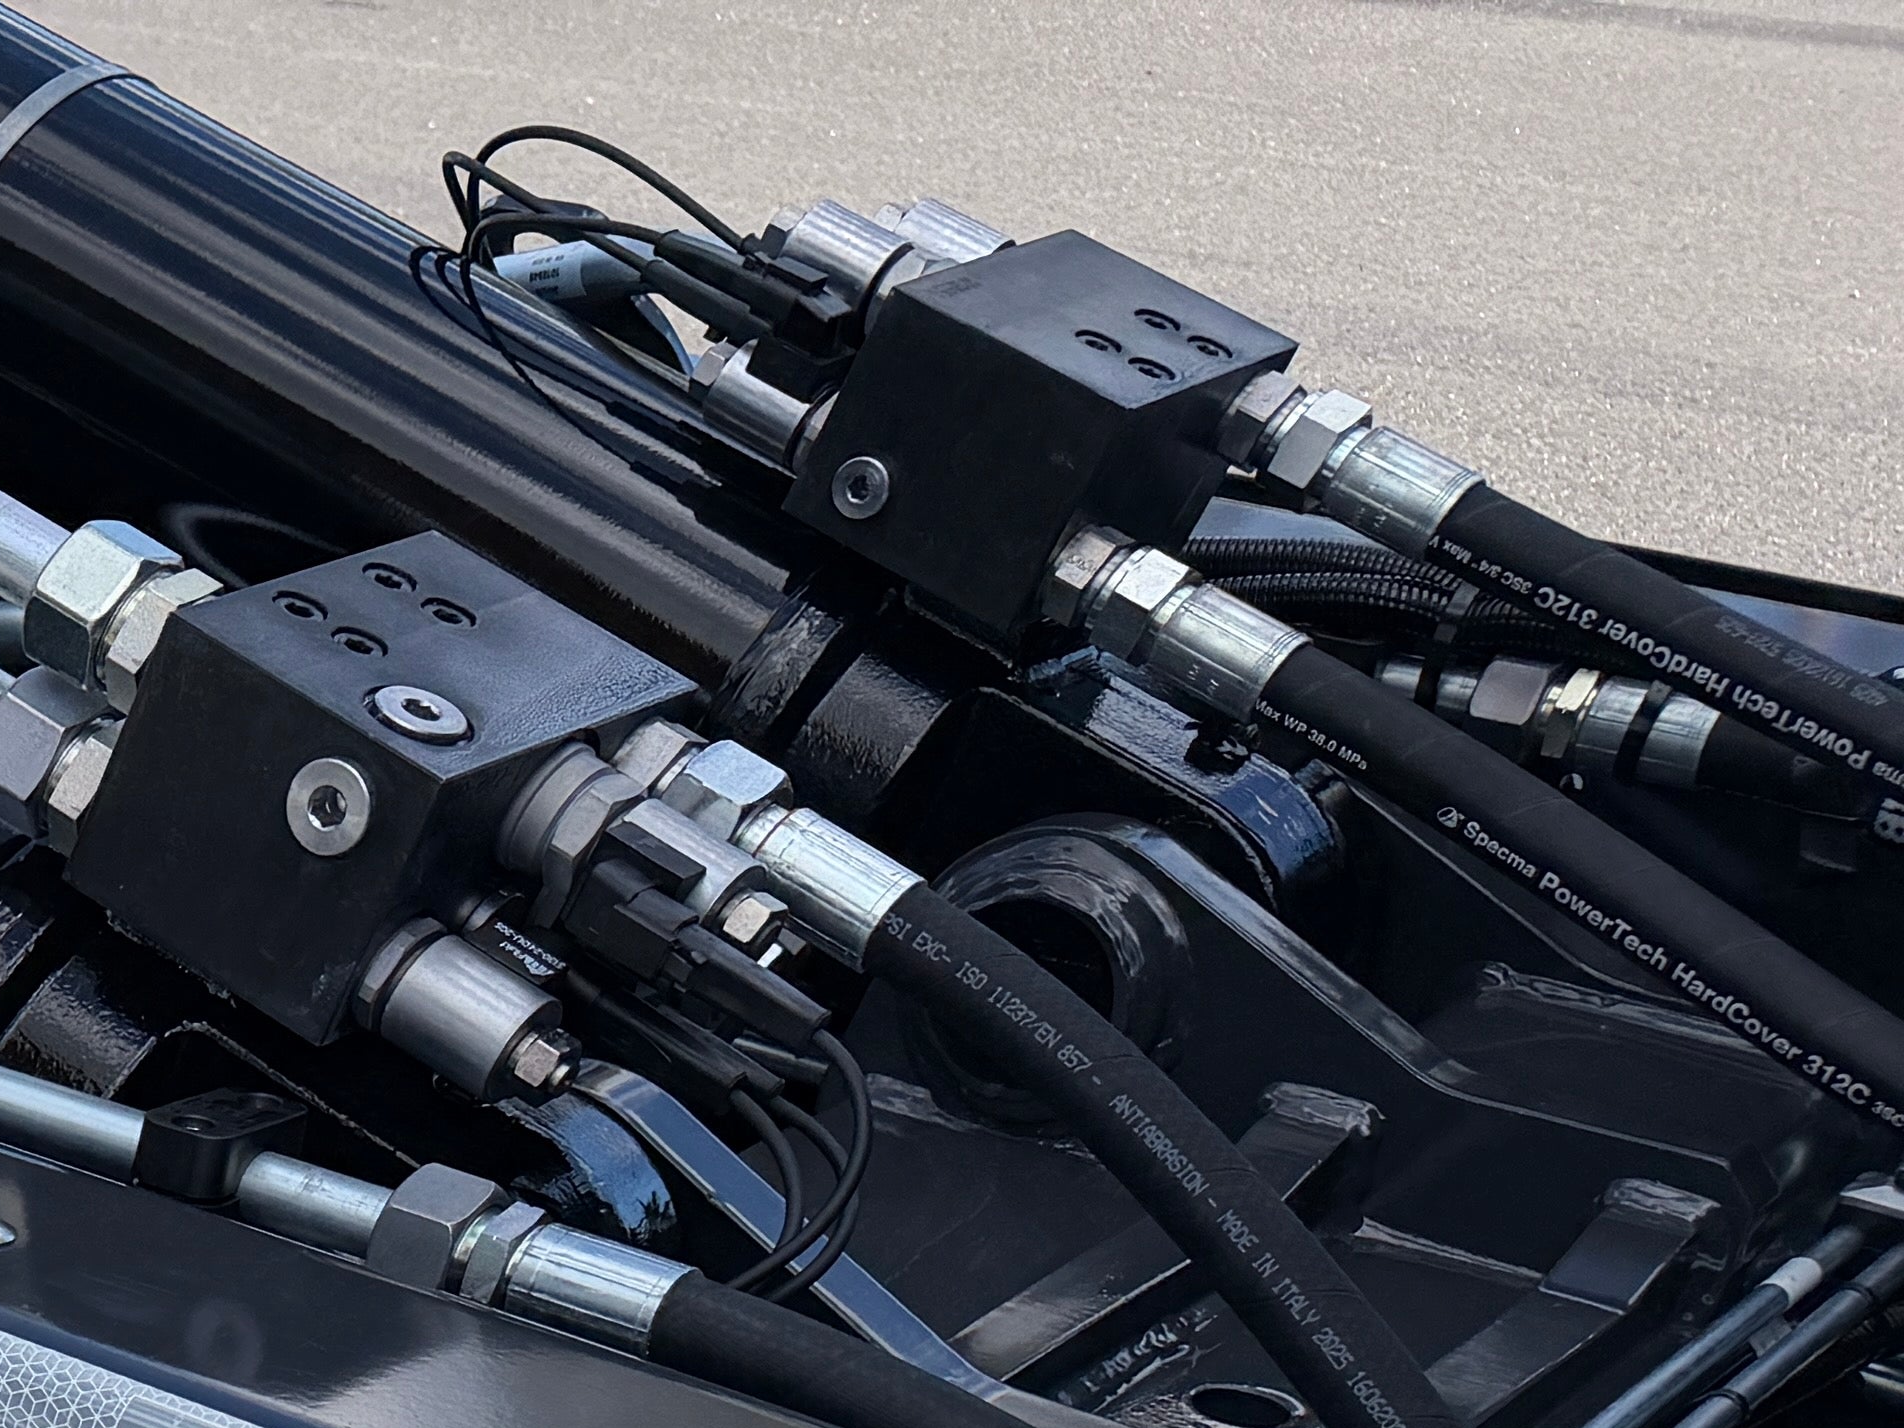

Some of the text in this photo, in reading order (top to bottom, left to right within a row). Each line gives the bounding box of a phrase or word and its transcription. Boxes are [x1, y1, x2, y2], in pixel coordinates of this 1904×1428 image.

[1443, 542, 1472, 564] Max
[1534, 586, 1599, 631] 312C
[1601, 616, 1730, 695] HardCover
[1284, 713, 1308, 735] WP
[1308, 728, 1337, 754] 38.0
[1337, 745, 1368, 771] MPa
[1733, 692, 1873, 771] PowerTech
[1463, 821, 1538, 880] Specma
[1538, 871, 1669, 972] PowerTech
[1671, 961, 1803, 1061] HardCover
[1802, 1054, 1873, 1106] 312C
[955, 960, 989, 991] ISO
[1056, 1043, 1094, 1073] 857
[1107, 1093, 1211, 1198] ANTIABRASION
[1215, 1207, 1261, 1255] MADE
[1251, 1251, 1281, 1279] IN
[1271, 1276, 1322, 1327] ITALY
